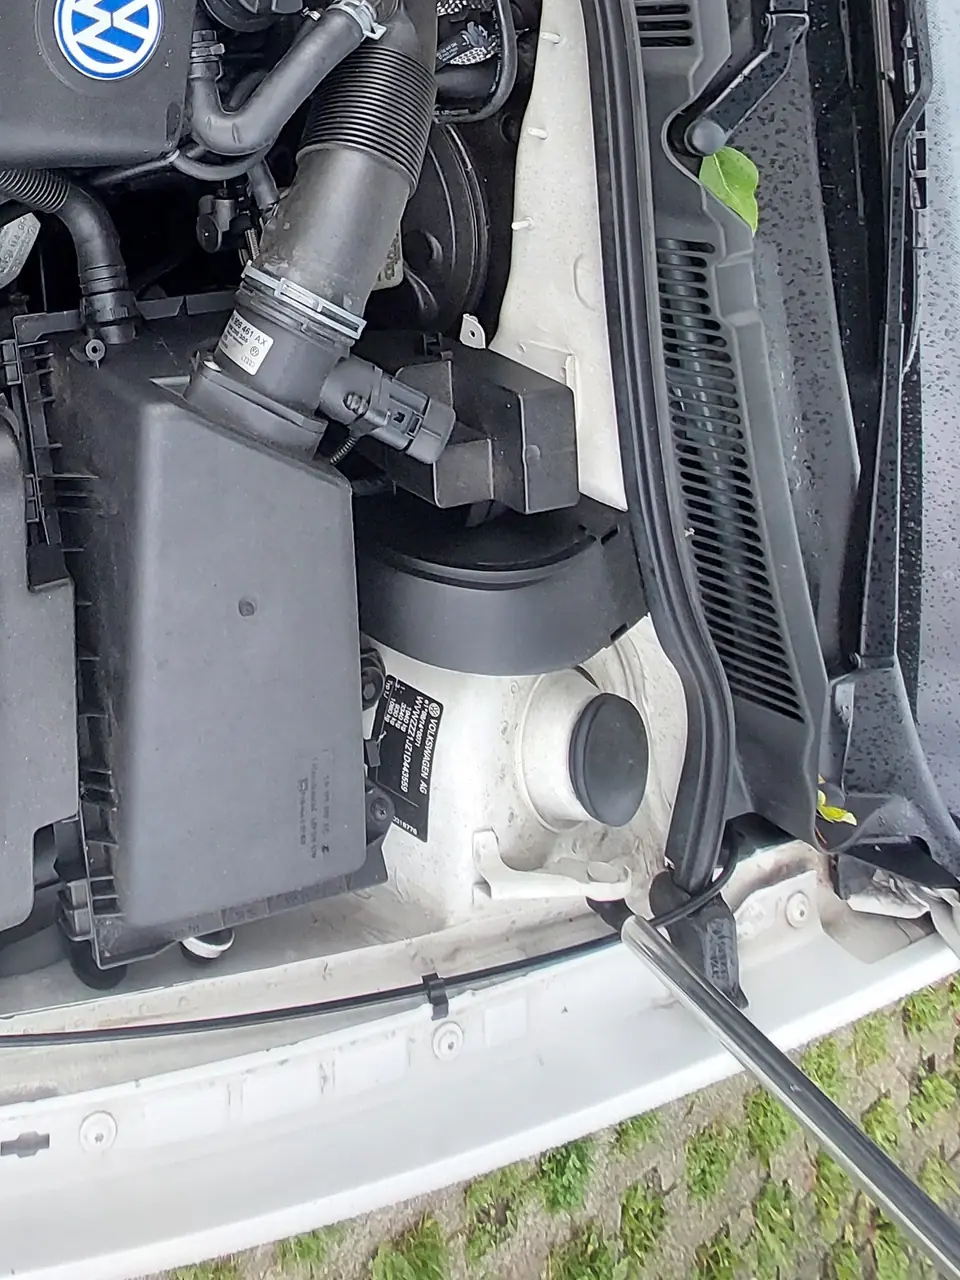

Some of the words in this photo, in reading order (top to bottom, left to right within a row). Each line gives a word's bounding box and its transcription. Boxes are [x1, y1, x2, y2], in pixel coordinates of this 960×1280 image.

[242, 325, 254, 337] 461
[254, 335, 269, 347] AX
[421, 718, 438, 779] VOLKSWAGEN
[419, 780, 428, 795] AG
